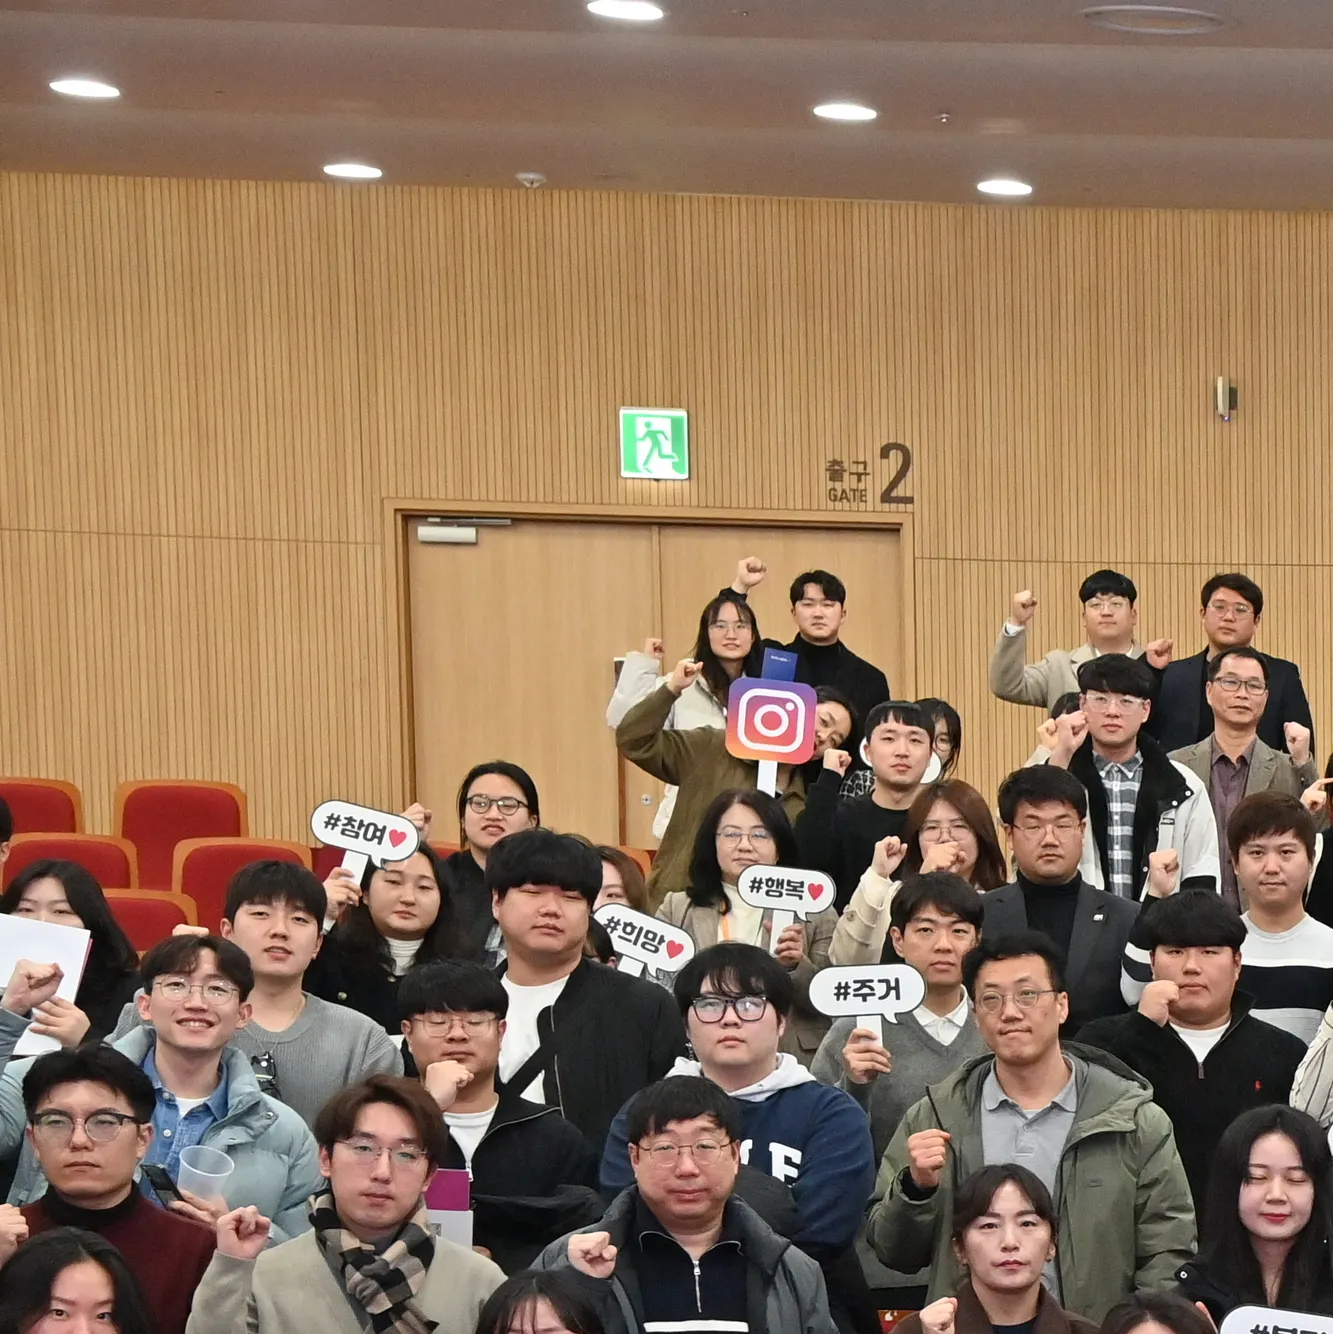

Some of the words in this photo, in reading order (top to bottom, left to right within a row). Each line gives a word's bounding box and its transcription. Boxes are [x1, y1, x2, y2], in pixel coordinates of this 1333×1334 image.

[826, 459, 870, 483] 출구
[880, 442, 914, 504] 2
[828, 488, 867, 503] GATE
[323, 812, 388, 847] #참여
[748, 876, 806, 901] #행복
[604, 915, 667, 955] #희망
[833, 977, 902, 1003] #주거
